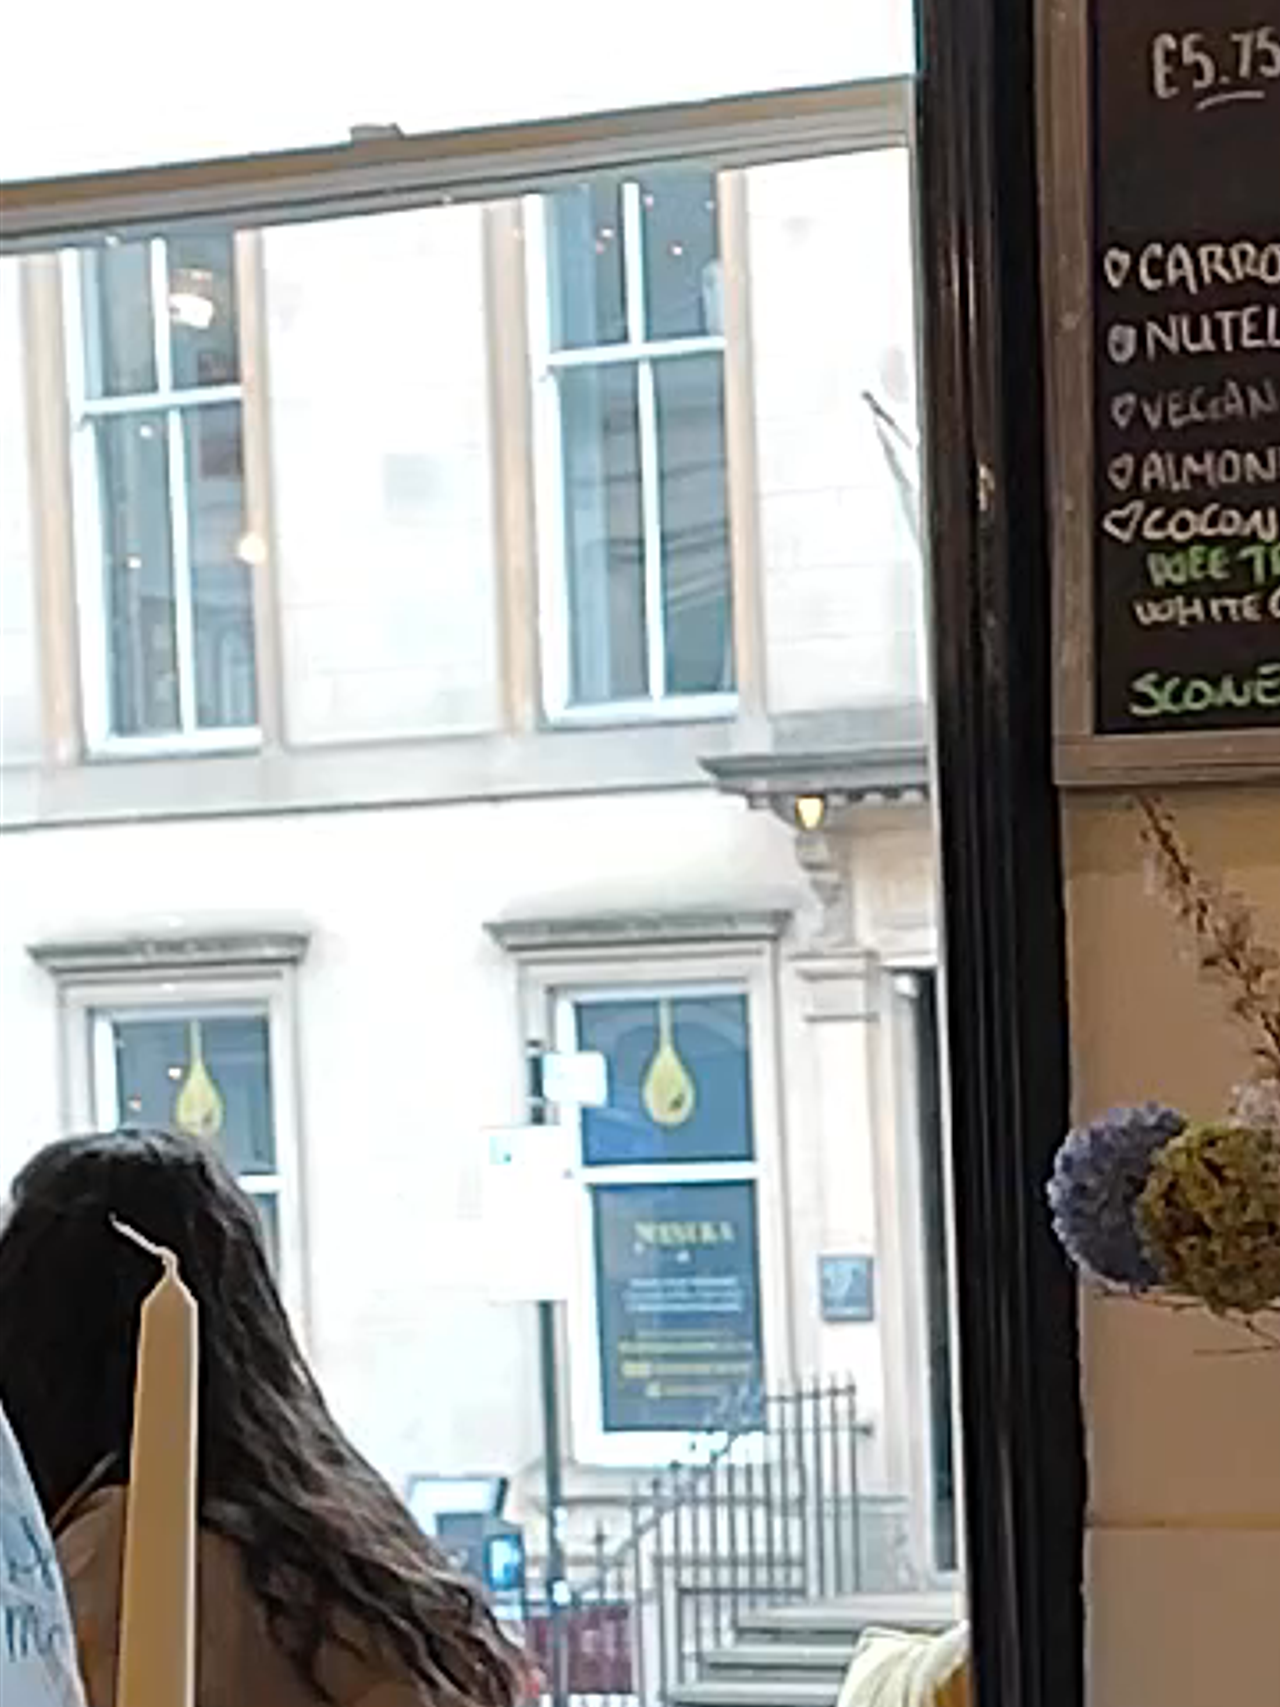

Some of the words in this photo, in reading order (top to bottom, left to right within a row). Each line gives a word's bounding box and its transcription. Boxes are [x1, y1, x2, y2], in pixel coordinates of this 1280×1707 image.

[1141, 379, 1278, 430] VEGAN
[1146, 543, 1231, 587] WEE
[1133, 592, 1262, 626] WHITE
